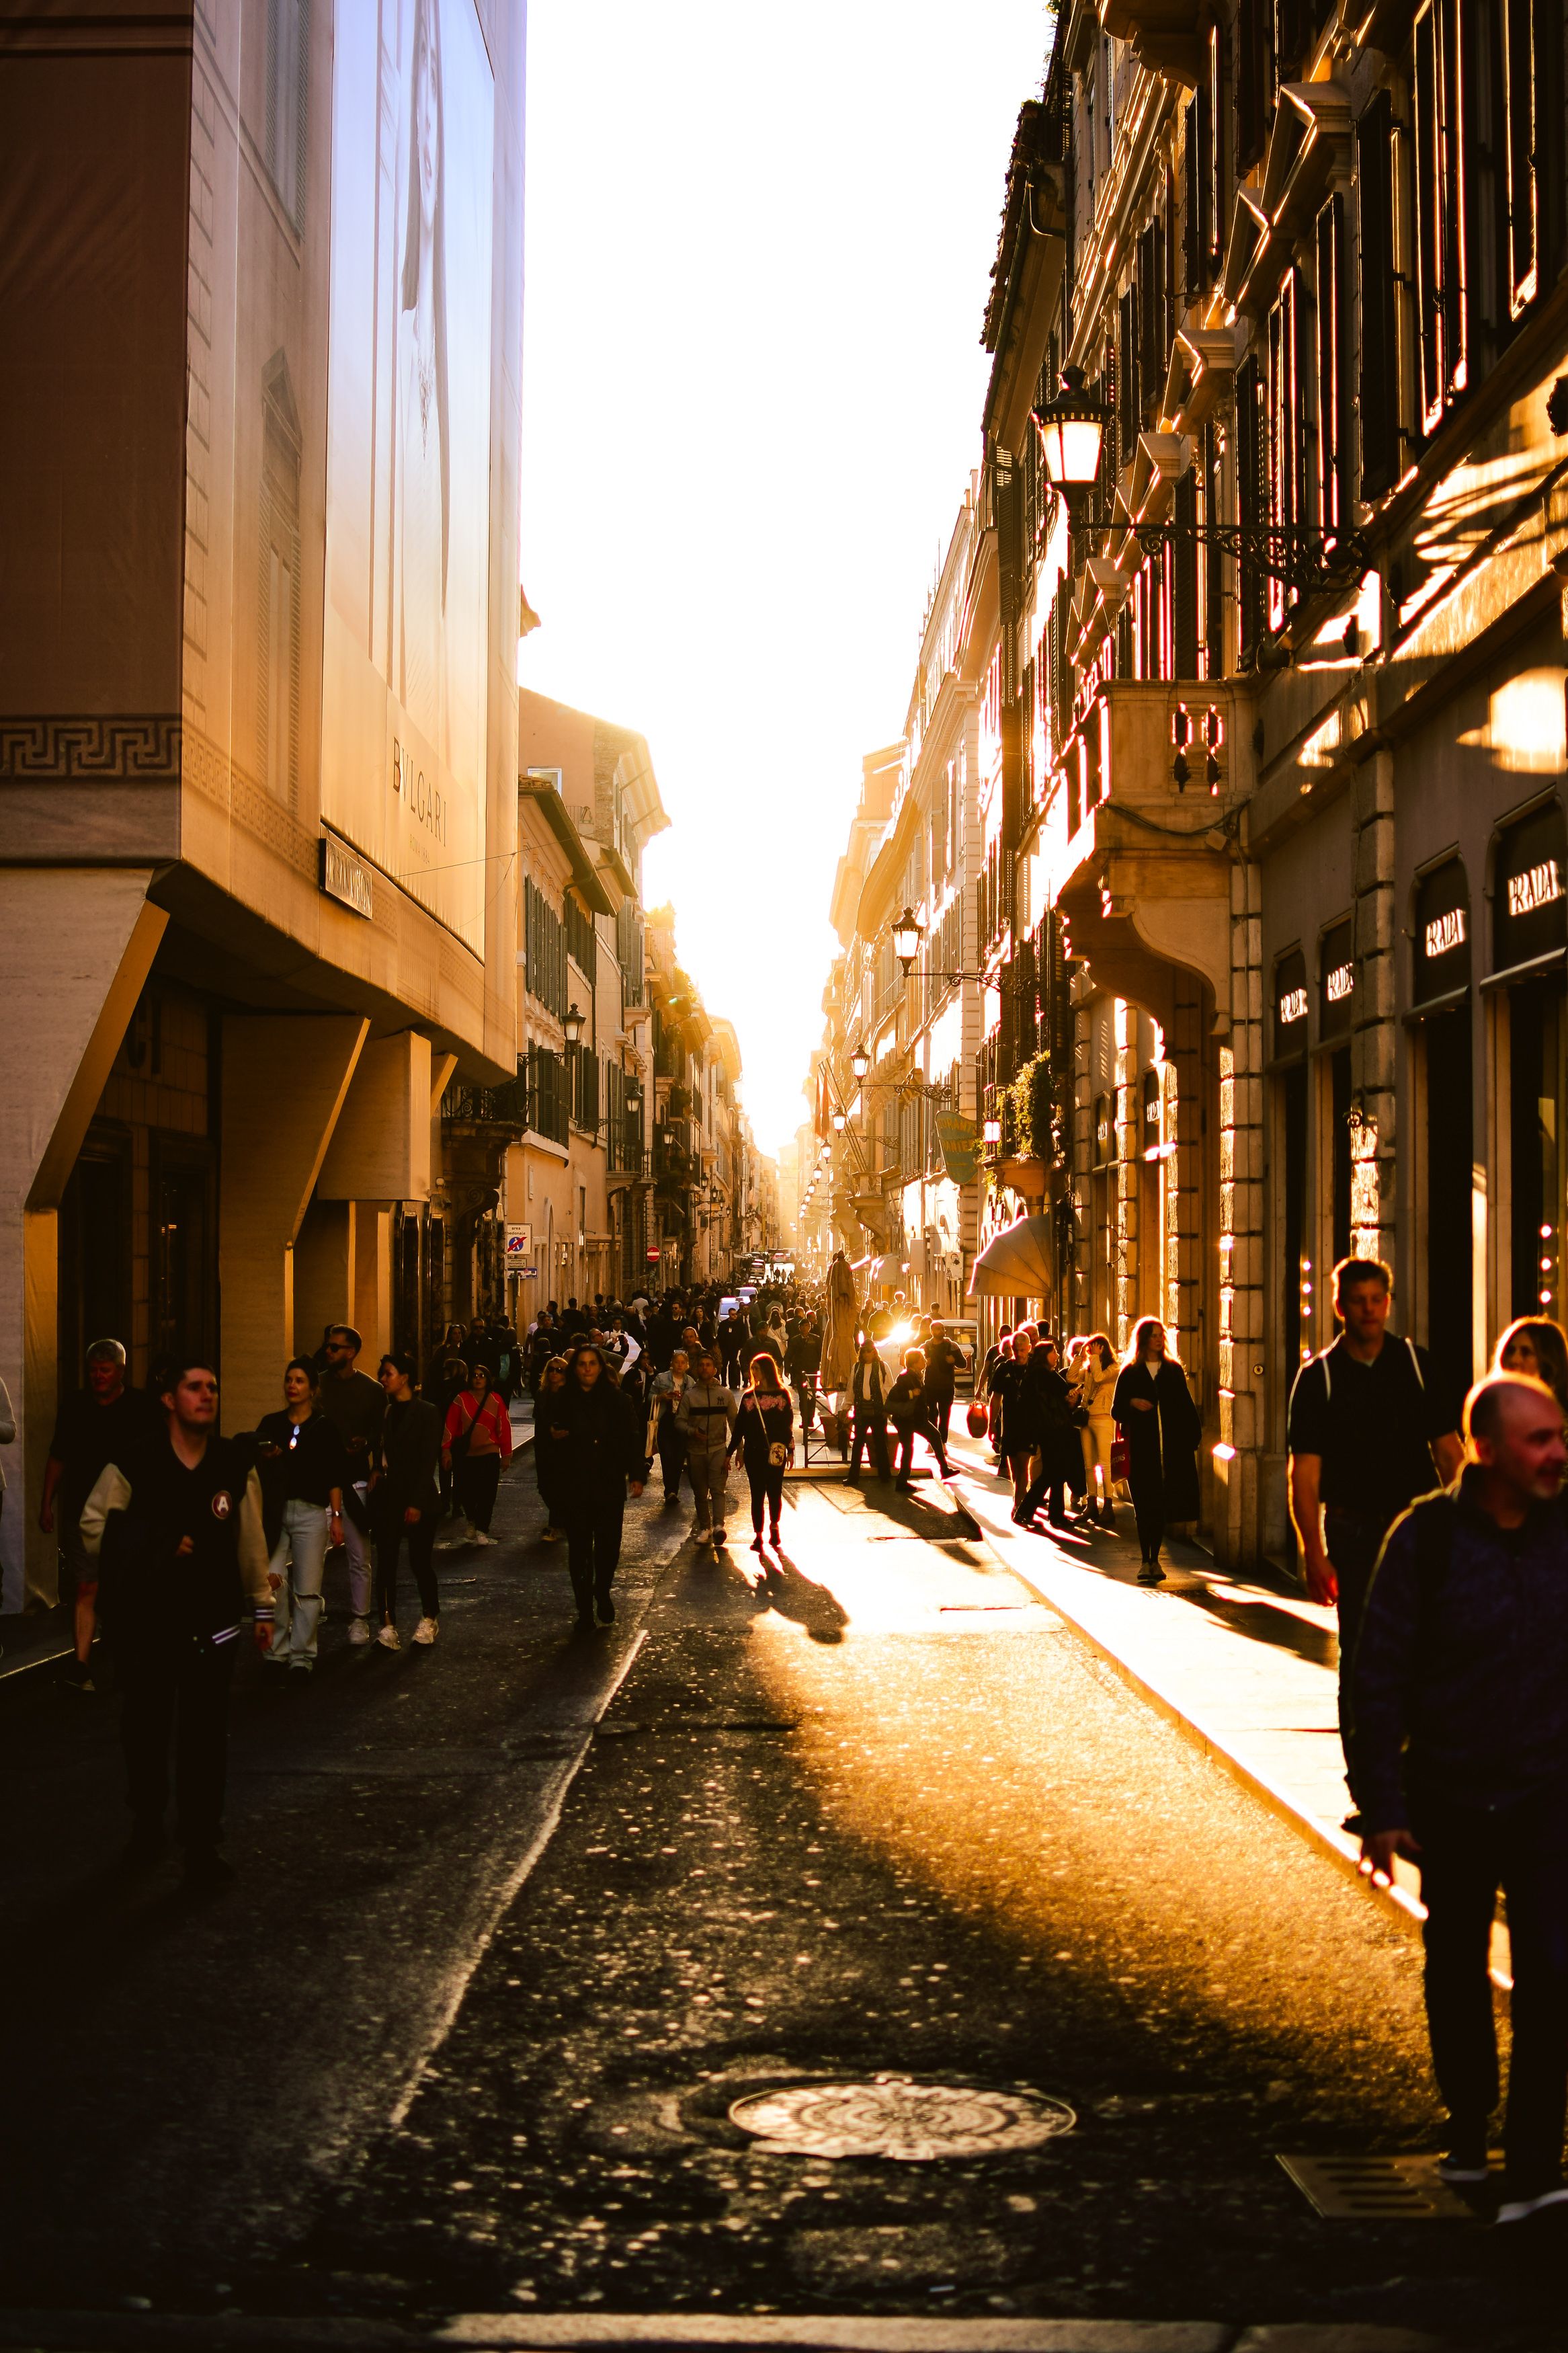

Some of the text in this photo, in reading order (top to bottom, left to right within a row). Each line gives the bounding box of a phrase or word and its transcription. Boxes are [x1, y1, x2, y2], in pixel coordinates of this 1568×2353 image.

[393, 737, 446, 848] BVLGARI
[1509, 861, 1558, 916] PRADA
[1427, 909, 1465, 957] PRADA
[217, 1496, 229, 1512] A
